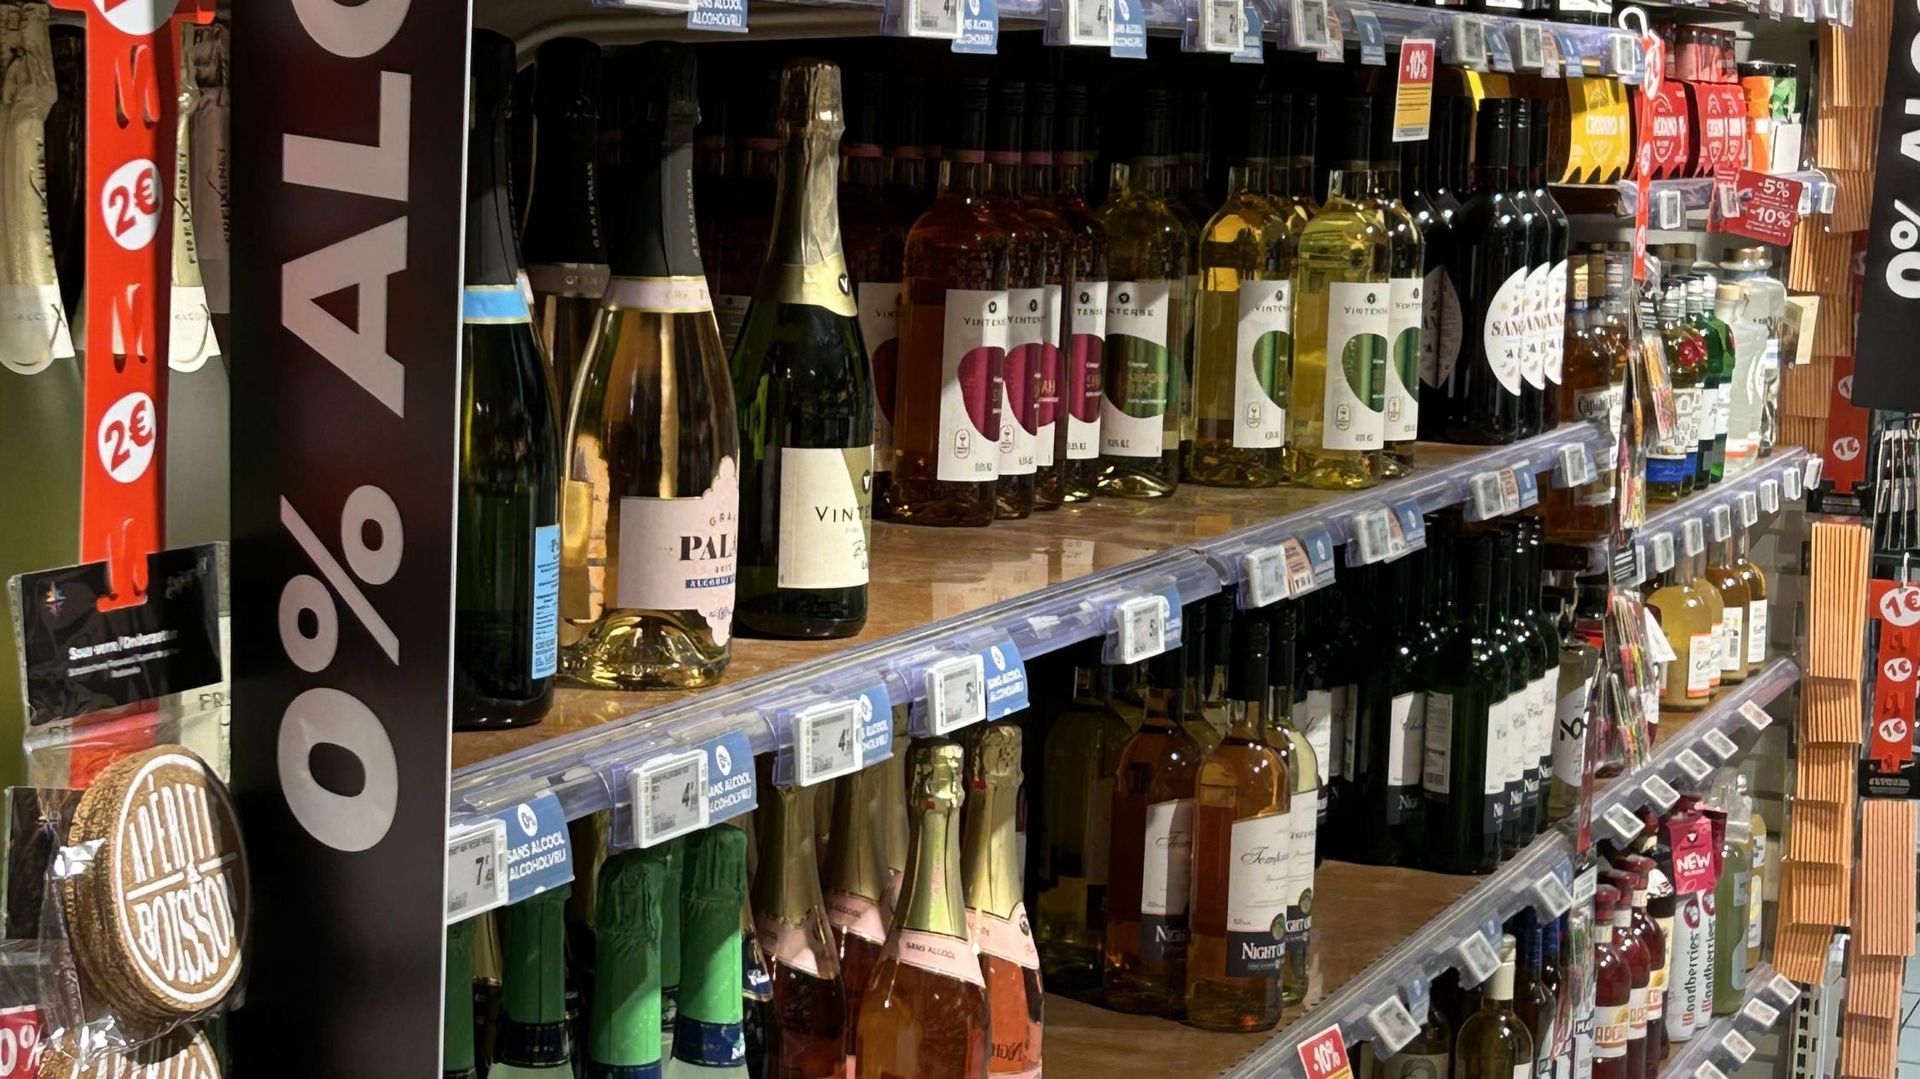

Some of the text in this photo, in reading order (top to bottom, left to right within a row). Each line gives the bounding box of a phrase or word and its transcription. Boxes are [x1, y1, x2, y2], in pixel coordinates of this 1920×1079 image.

[1406, 50, 1428, 79] -10%
[108, 166, 160, 239] 2€
[1758, 178, 1790, 198] -5%
[1750, 206, 1791, 228] -10%
[103, 399, 155, 473] 2€
[1885, 590, 1920, 618] 1€
[277, 484, 404, 852] 0%
[1887, 660, 1910, 677] 1€
[1882, 720, 1905, 737] 1€
[129, 774, 222, 884] APÉRITI
[531, 831, 566, 854] ALCOOL
[509, 848, 567, 881] ALCOHOLVRIJ
[1676, 852, 1713, 873] NEW
[1682, 932, 1699, 1027] Woodberries
[1314, 1038, 1341, 1075] -10%
